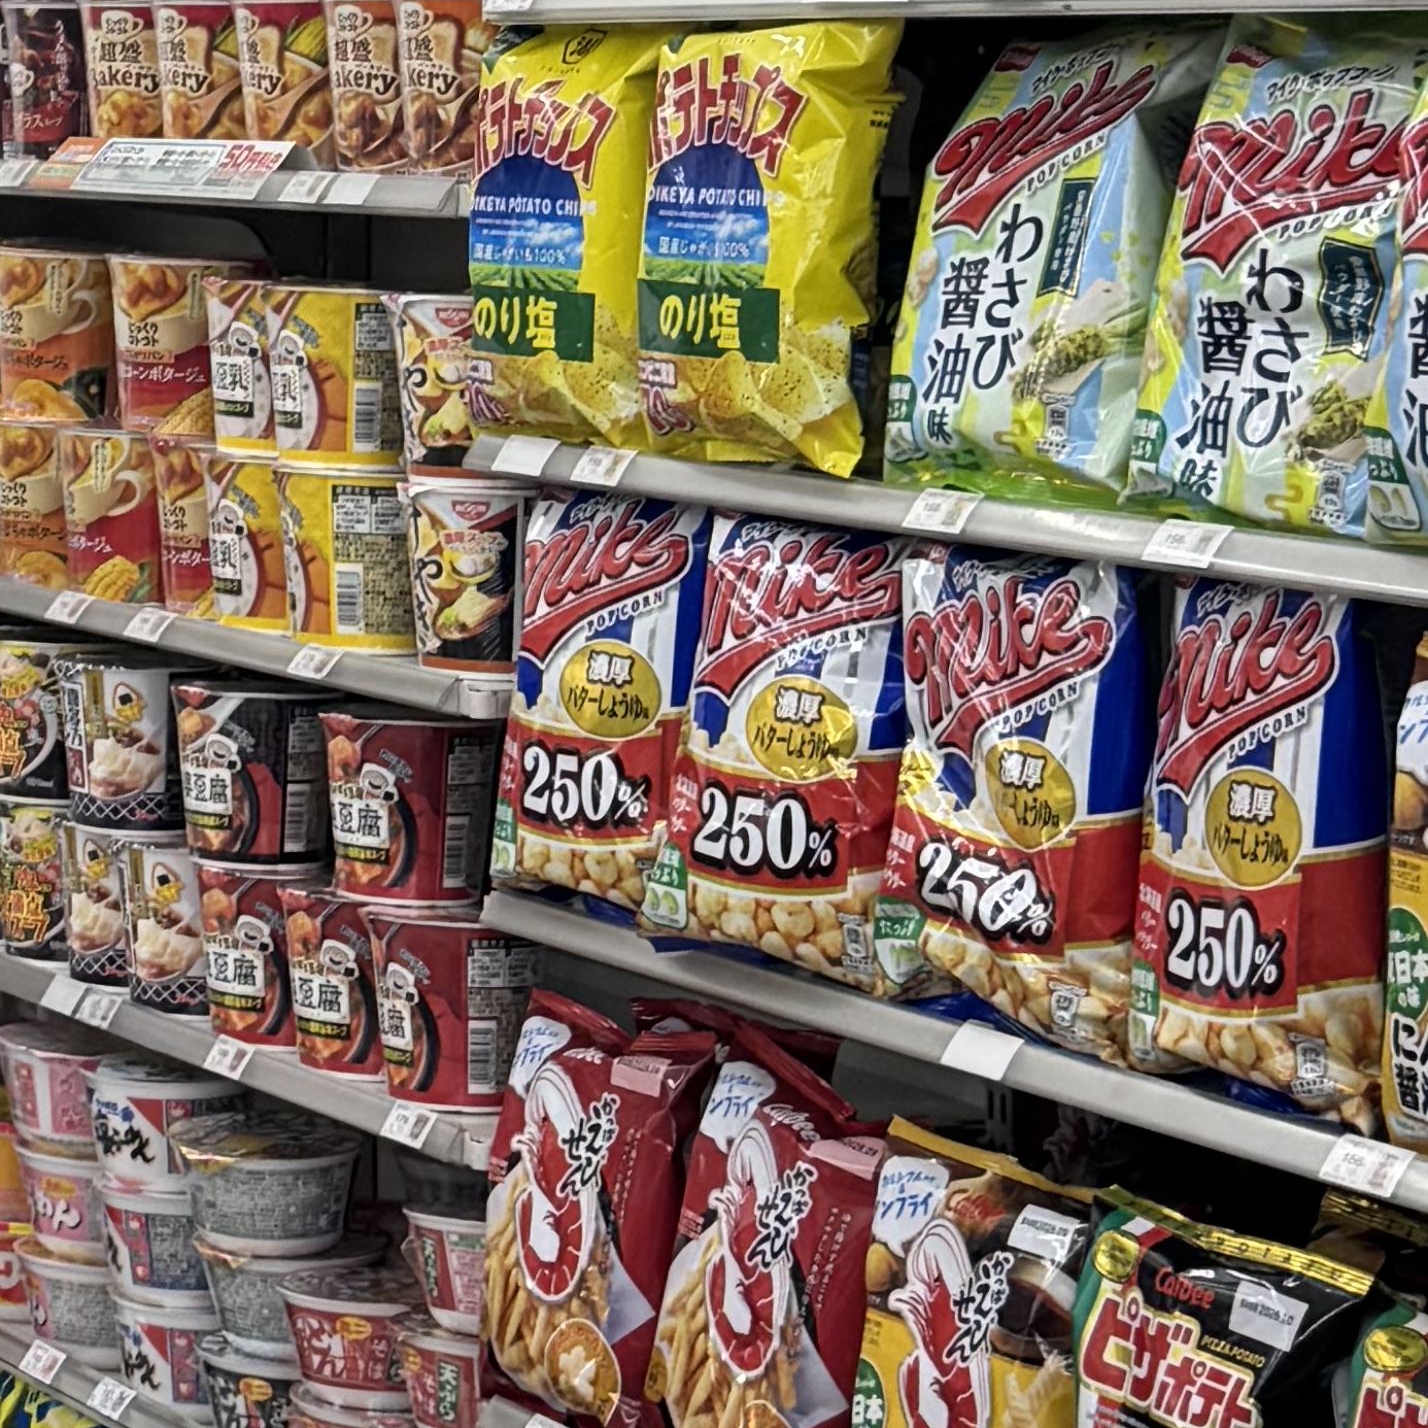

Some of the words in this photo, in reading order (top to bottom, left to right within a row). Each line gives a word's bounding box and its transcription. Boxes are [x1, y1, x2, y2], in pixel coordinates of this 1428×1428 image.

[473, 295, 557, 350] のり塩
[659, 292, 741, 350] のり塩
[921, 257, 990, 405] 醤油
[972, 202, 1043, 391] わさび
[1176, 296, 1248, 458] 醤油
[1236, 247, 1304, 448] わさび
[586, 652, 632, 683] 濃厚
[775, 686, 821, 723] 濃厚
[522, 744, 650, 821] 250%
[1226, 779, 1276, 824] 濃厚
[693, 786, 835, 870] 250%
[917, 841, 1053, 935] 250%
[1165, 891, 1283, 995] 250%
